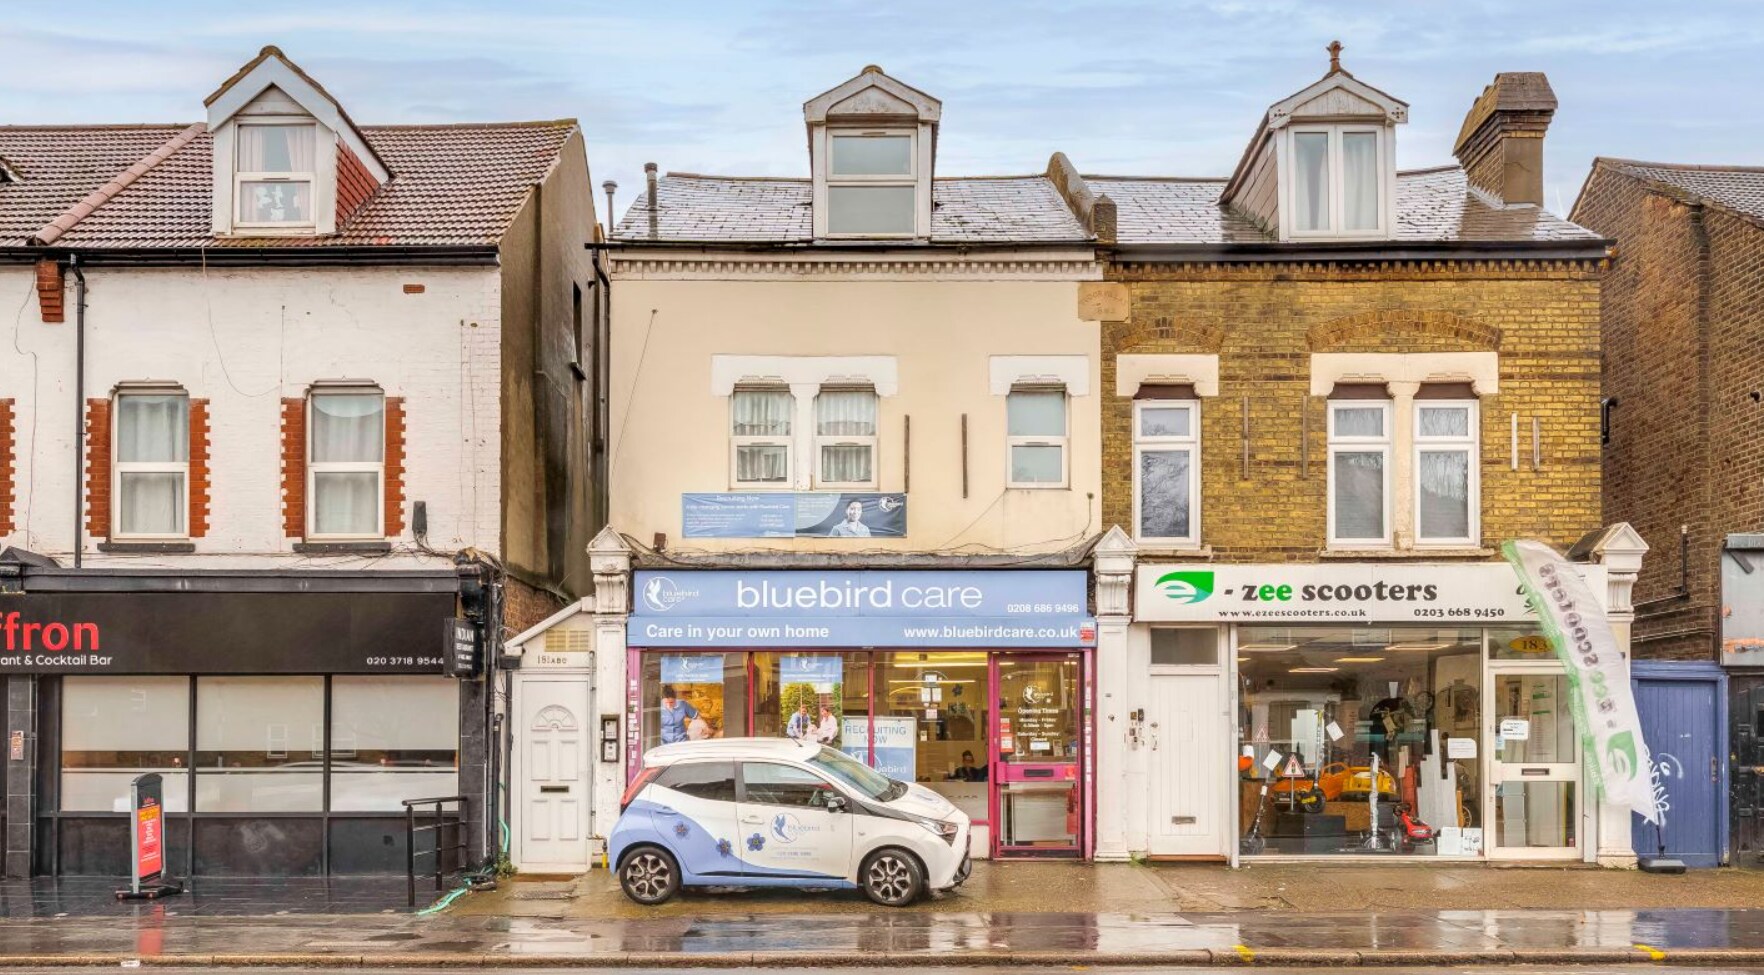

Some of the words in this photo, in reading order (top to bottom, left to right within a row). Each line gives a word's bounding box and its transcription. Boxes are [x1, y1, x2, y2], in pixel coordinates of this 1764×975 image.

[737, 579, 892, 608] bluebird
[901, 586, 983, 608] care
[1241, 583, 1293, 602] zee
[1301, 580, 1438, 602] scooters
[1007, 603, 1032, 613] 0208
[1033, 603, 1053, 613] 686
[1055, 603, 1079, 613] 9496
[1218, 607, 1367, 618] www.ezeescooters.co.uk
[1413, 607, 1445, 618] 0203
[1447, 607, 1471, 617] 668
[1473, 607, 1505, 618] 9450
[0, 610, 100, 651] fron
[646, 623, 683, 639] Care
[686, 623, 702, 639] in
[706, 625, 744, 642] your
[746, 626, 781, 639] own
[784, 623, 830, 639] home
[903, 625, 1078, 639] www.bluebirdcare.co.uk
[24, 655, 33, 665] &
[35, 654, 87, 666] Cocktail
[89, 655, 113, 666] Bar
[366, 656, 387, 666] 020
[389, 656, 413, 666] 3718
[416, 656, 444, 666] 9544
[1018, 707, 1041, 715] Opening
[845, 725, 907, 735] RECUITING
